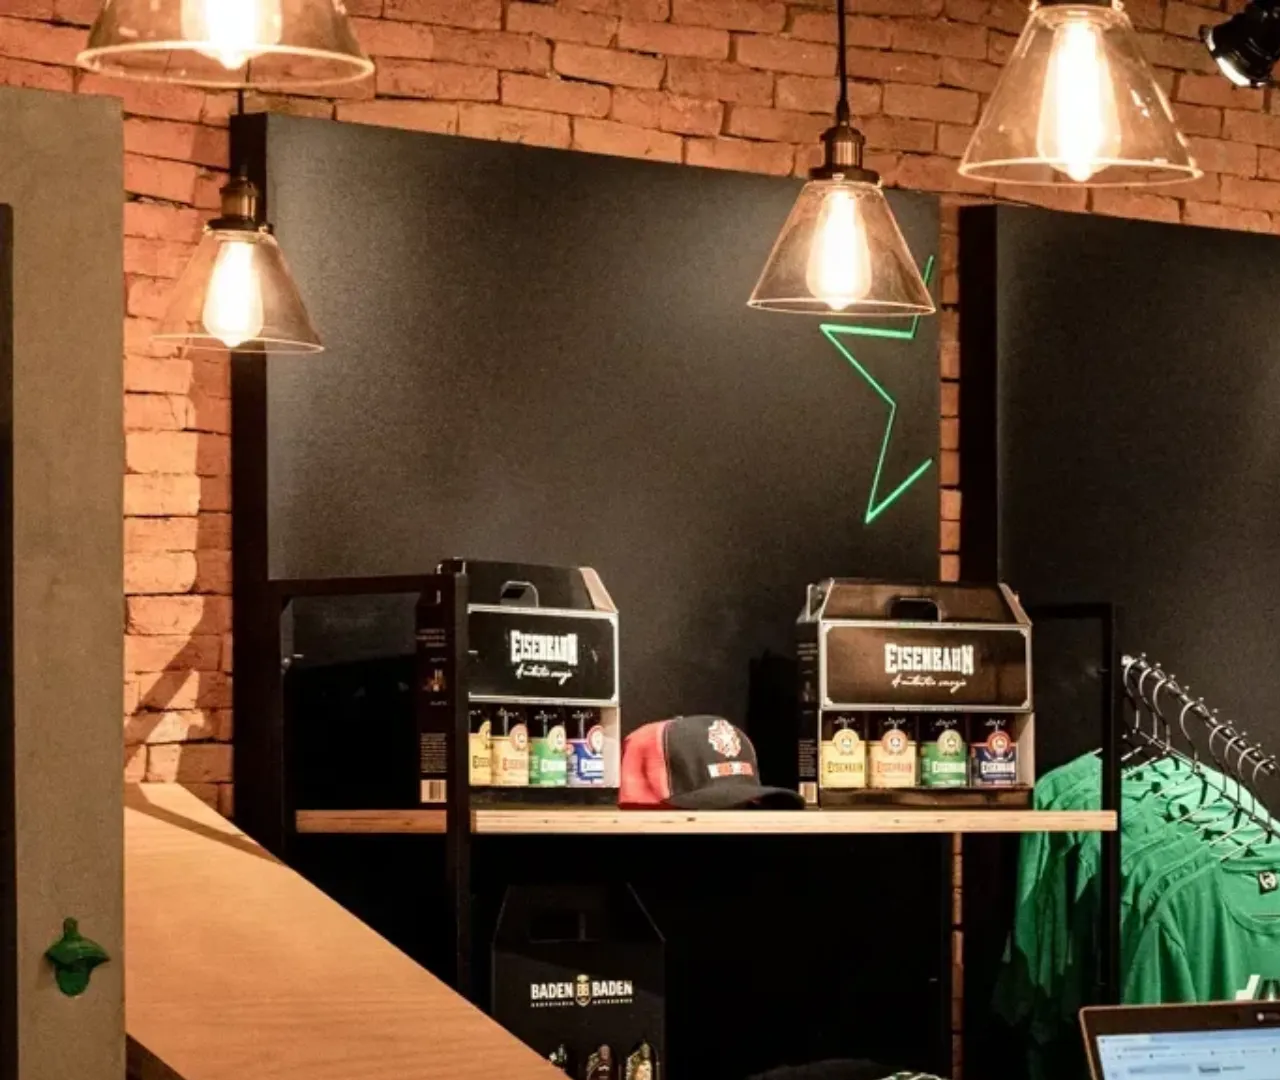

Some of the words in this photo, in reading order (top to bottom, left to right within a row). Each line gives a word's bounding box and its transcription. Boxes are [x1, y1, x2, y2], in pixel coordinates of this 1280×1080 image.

[884, 643, 974, 675] EISENBAHN
[530, 982, 574, 1000] BADEN
[591, 980, 633, 997] BADEN
